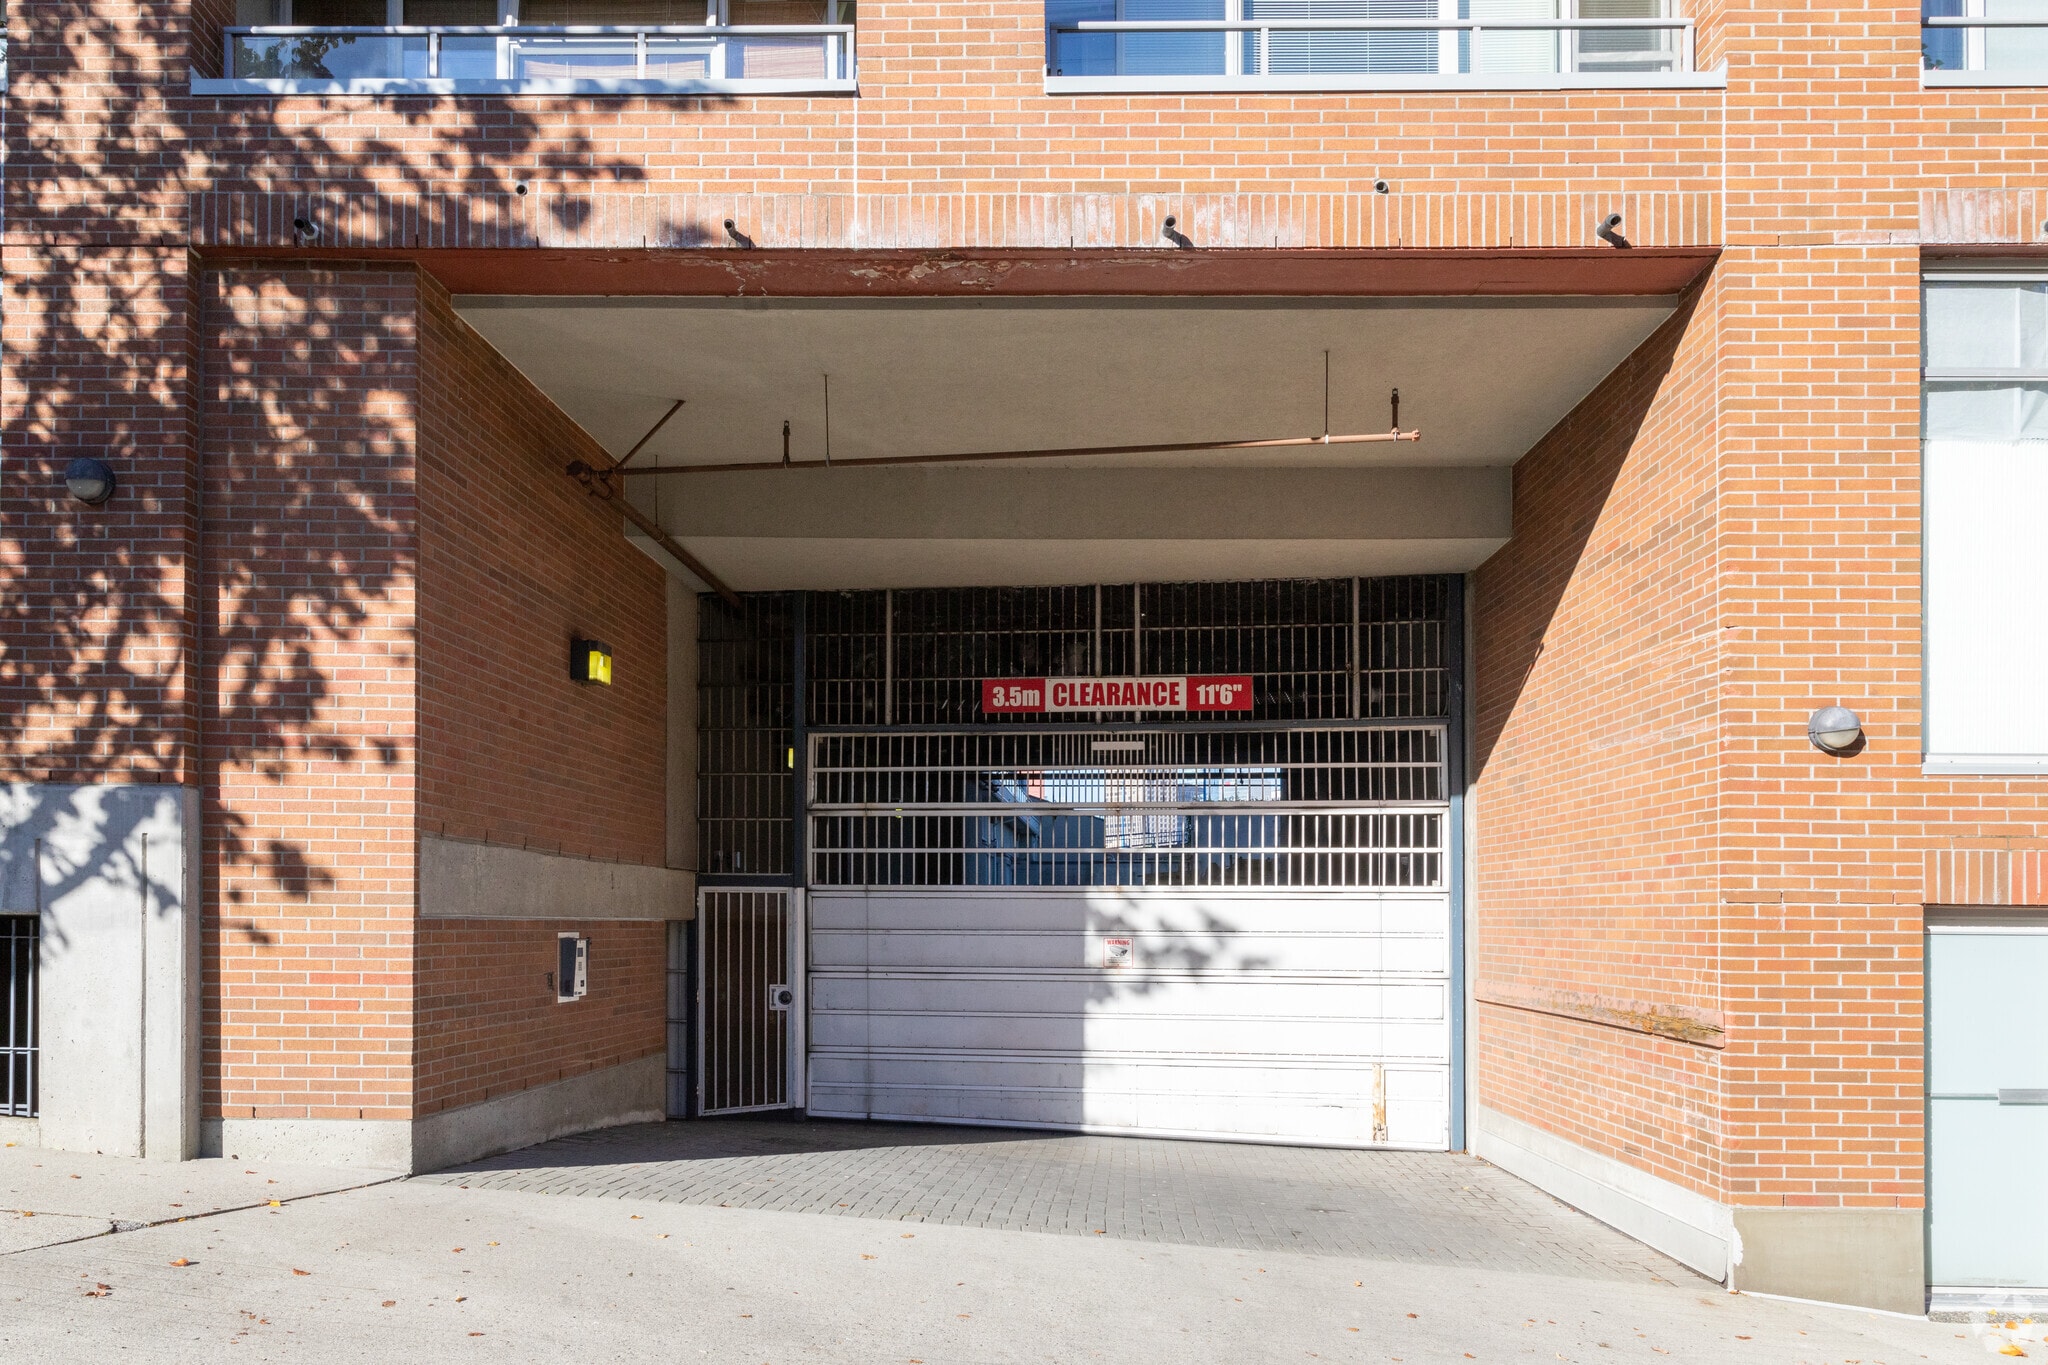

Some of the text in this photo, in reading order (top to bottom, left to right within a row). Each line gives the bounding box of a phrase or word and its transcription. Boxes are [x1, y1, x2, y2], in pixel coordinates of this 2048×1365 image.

[992, 681, 1243, 707] 3.5m CLEARANCE 11'6"
